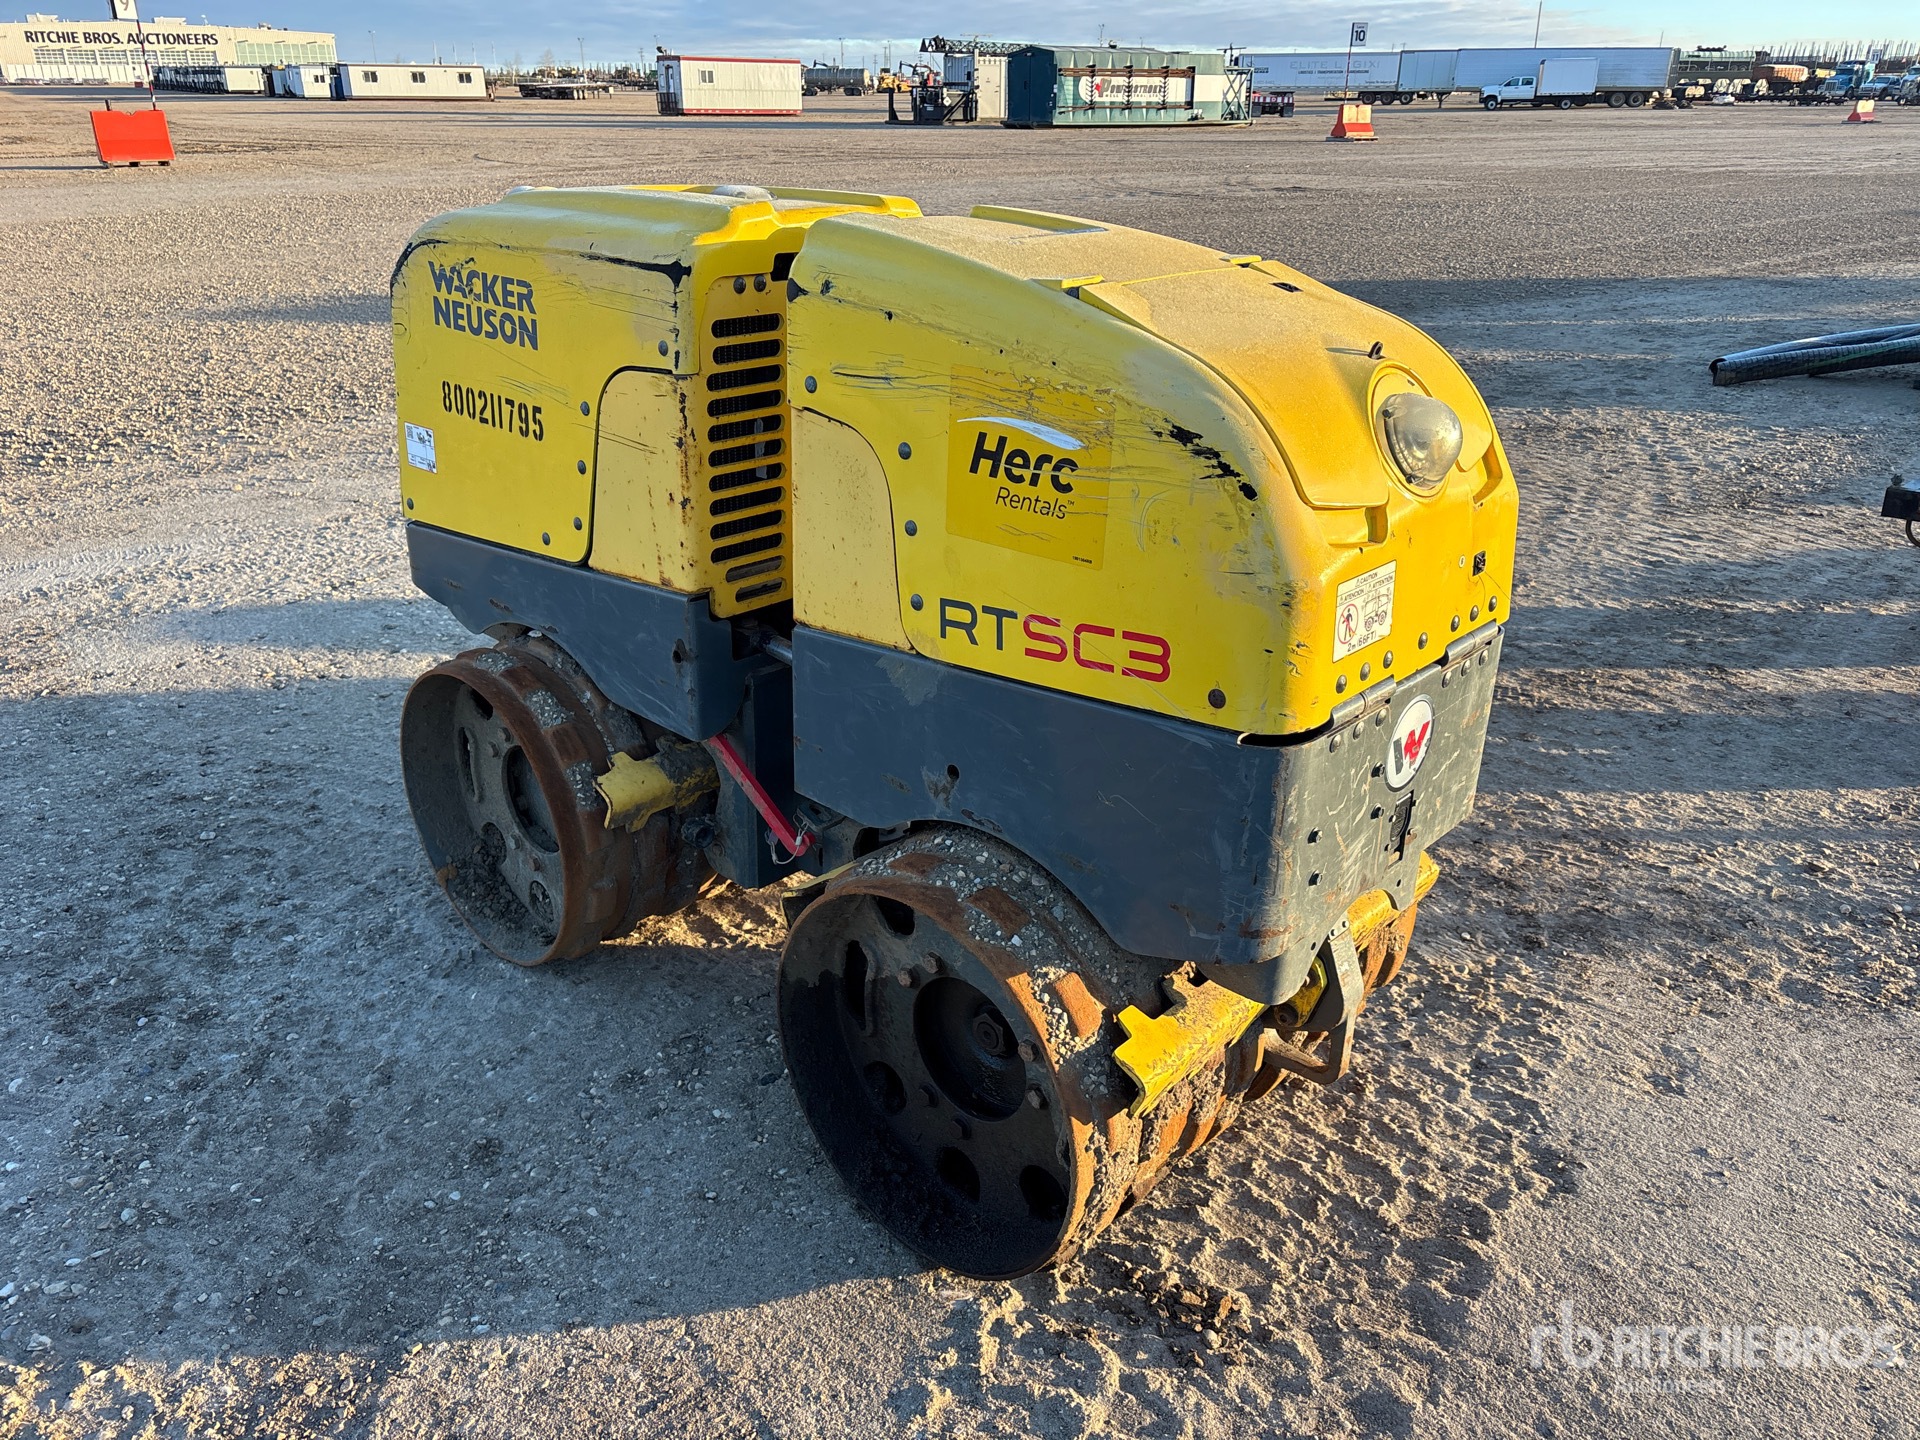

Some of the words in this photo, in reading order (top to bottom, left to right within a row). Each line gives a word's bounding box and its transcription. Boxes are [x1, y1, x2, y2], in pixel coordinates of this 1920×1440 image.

[24, 30, 80, 44] RITCHIE
[83, 31, 124, 45] BROS.
[127, 32, 219, 46] AUCTIONEERS
[1355, 30, 1366, 42] 10
[1289, 60, 1328, 69] ELITE
[428, 259, 537, 315] WACKER
[432, 296, 539, 351] NEUSON
[441, 380, 545, 442] 800211795
[968, 431, 1080, 494] Herc
[995, 486, 1067, 520] Rentals
[1359, 572, 1378, 584] CAUTION
[1372, 575, 1394, 588] ATTENTION
[939, 597, 1171, 683] RTSC3
